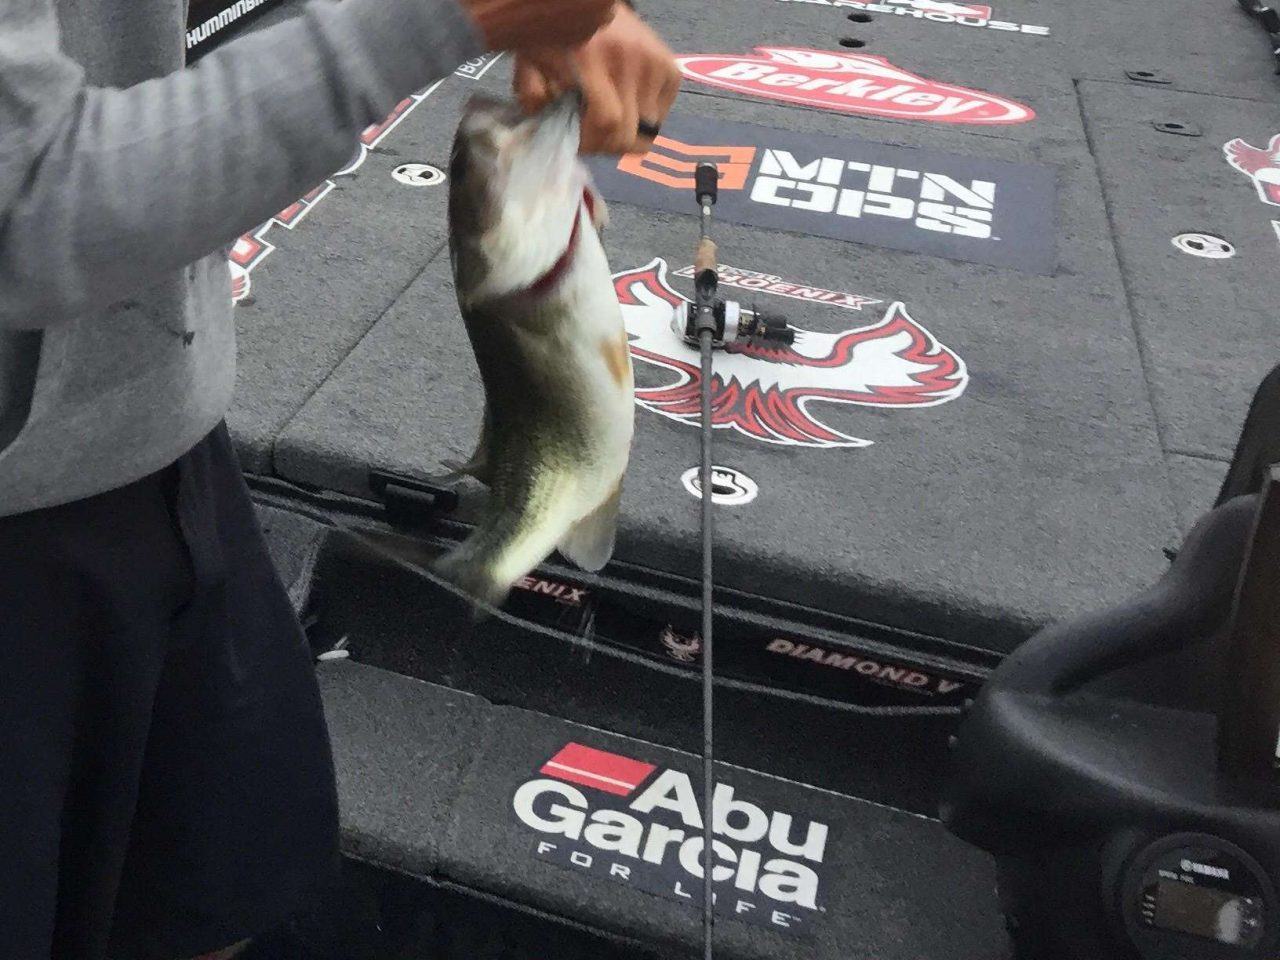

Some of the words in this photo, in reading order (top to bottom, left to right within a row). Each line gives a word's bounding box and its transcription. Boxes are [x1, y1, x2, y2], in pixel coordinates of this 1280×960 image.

[708, 61, 985, 116] Berkley
[758, 148, 996, 210] MTN
[750, 175, 993, 239] OPS
[683, 267, 865, 307] HOENIX
[513, 575, 589, 603] ENIX
[766, 638, 929, 687] DIAMOND
[629, 768, 828, 863] Abu
[513, 778, 819, 911] Garcia
[537, 841, 631, 881] FOR
